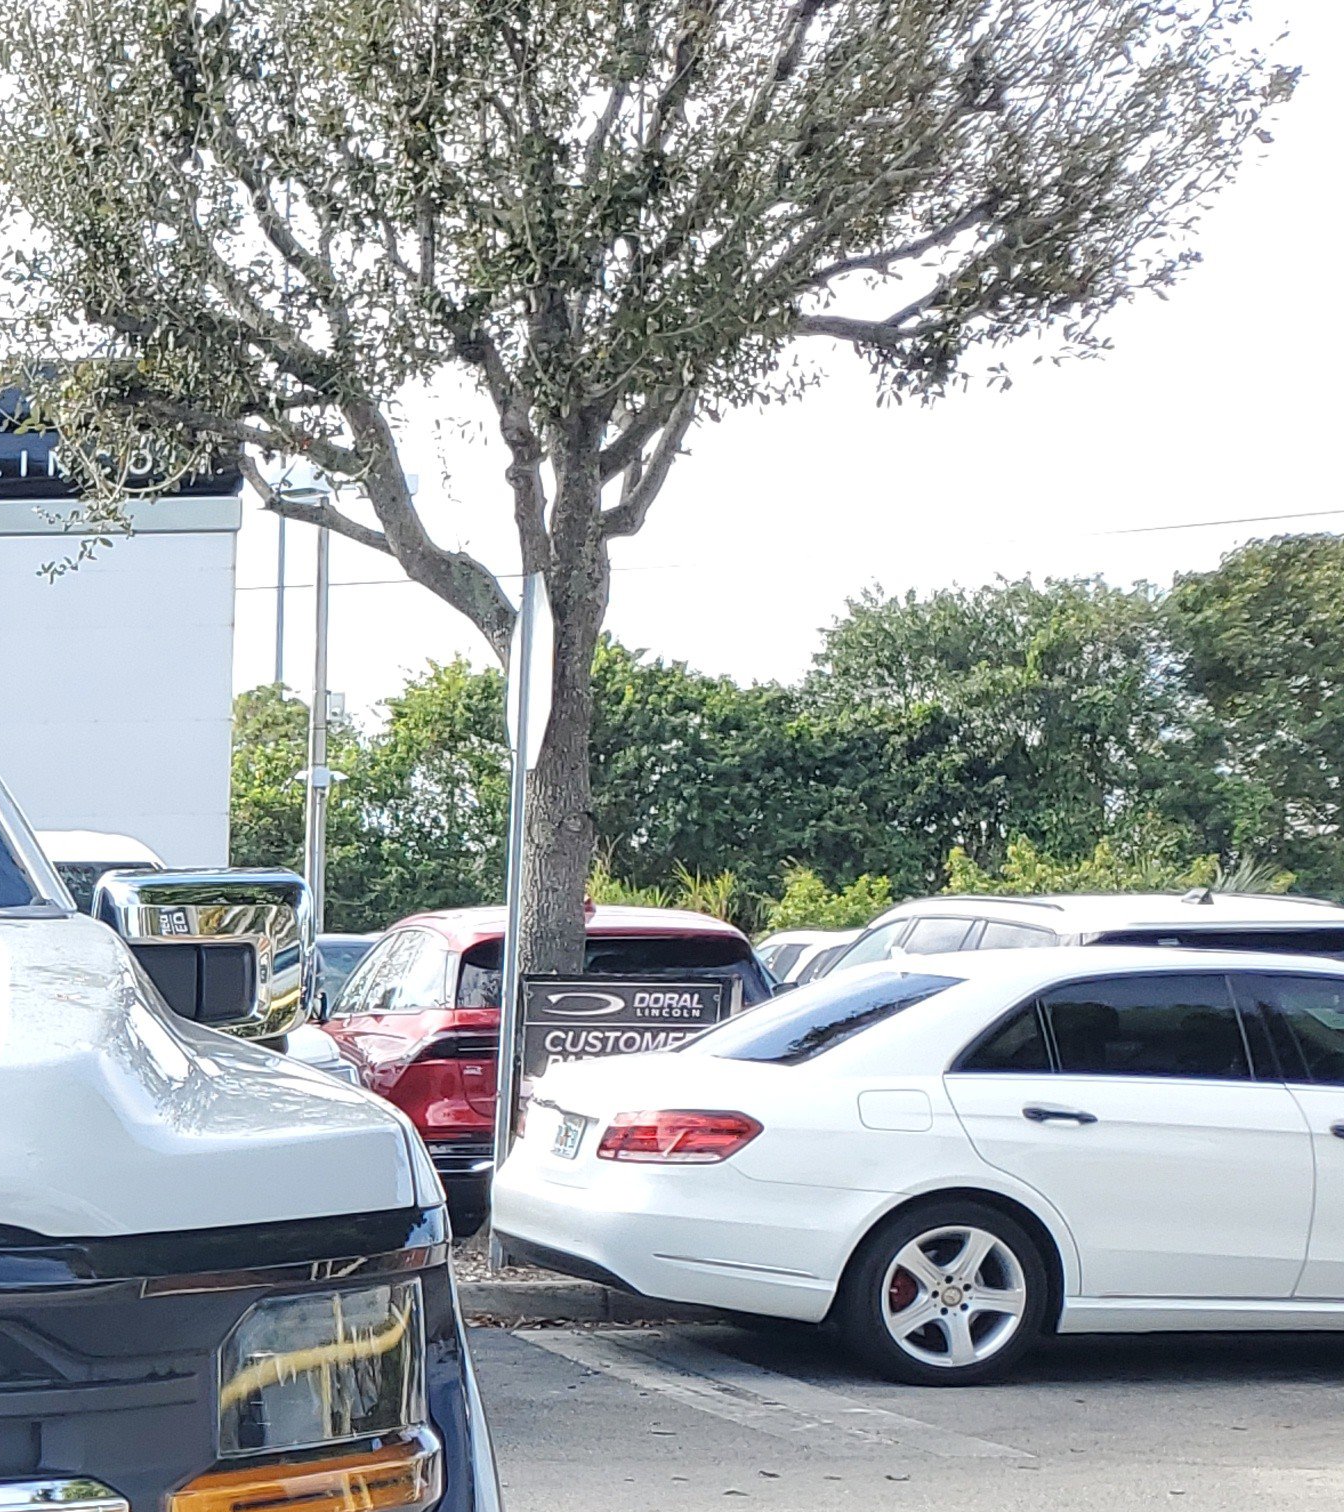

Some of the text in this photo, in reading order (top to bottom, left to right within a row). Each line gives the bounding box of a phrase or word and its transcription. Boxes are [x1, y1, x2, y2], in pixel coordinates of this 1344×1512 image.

[633, 992, 703, 1009] DORAL
[636, 1008, 701, 1018] LINCOLN
[544, 1030, 698, 1053] CUSTOME
